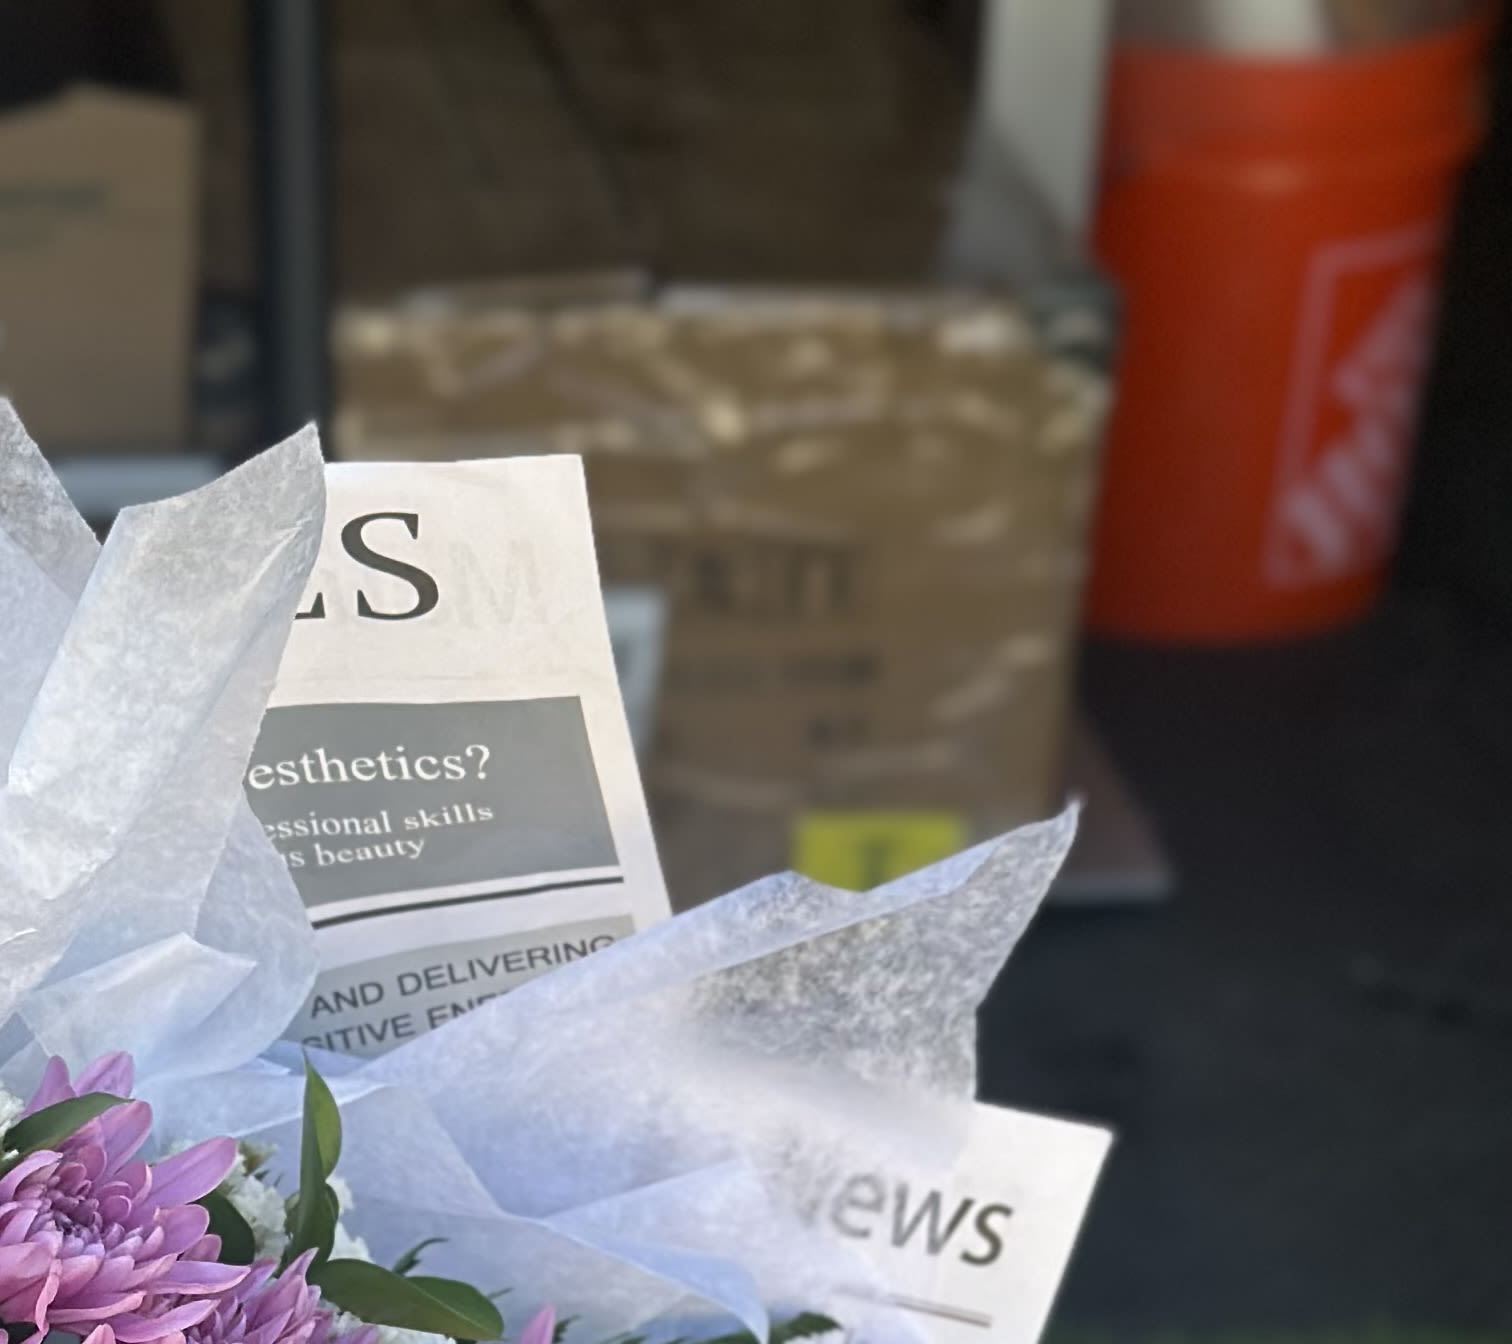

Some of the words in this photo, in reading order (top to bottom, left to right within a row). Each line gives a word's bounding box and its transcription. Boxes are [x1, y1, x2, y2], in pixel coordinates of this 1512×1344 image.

[295, 512, 439, 620] S
[248, 744, 490, 790] esthetics?
[404, 803, 493, 830] skills
[316, 836, 425, 867] beauty
[310, 982, 384, 1019] AND
[806, 1172, 1014, 1267] ews
